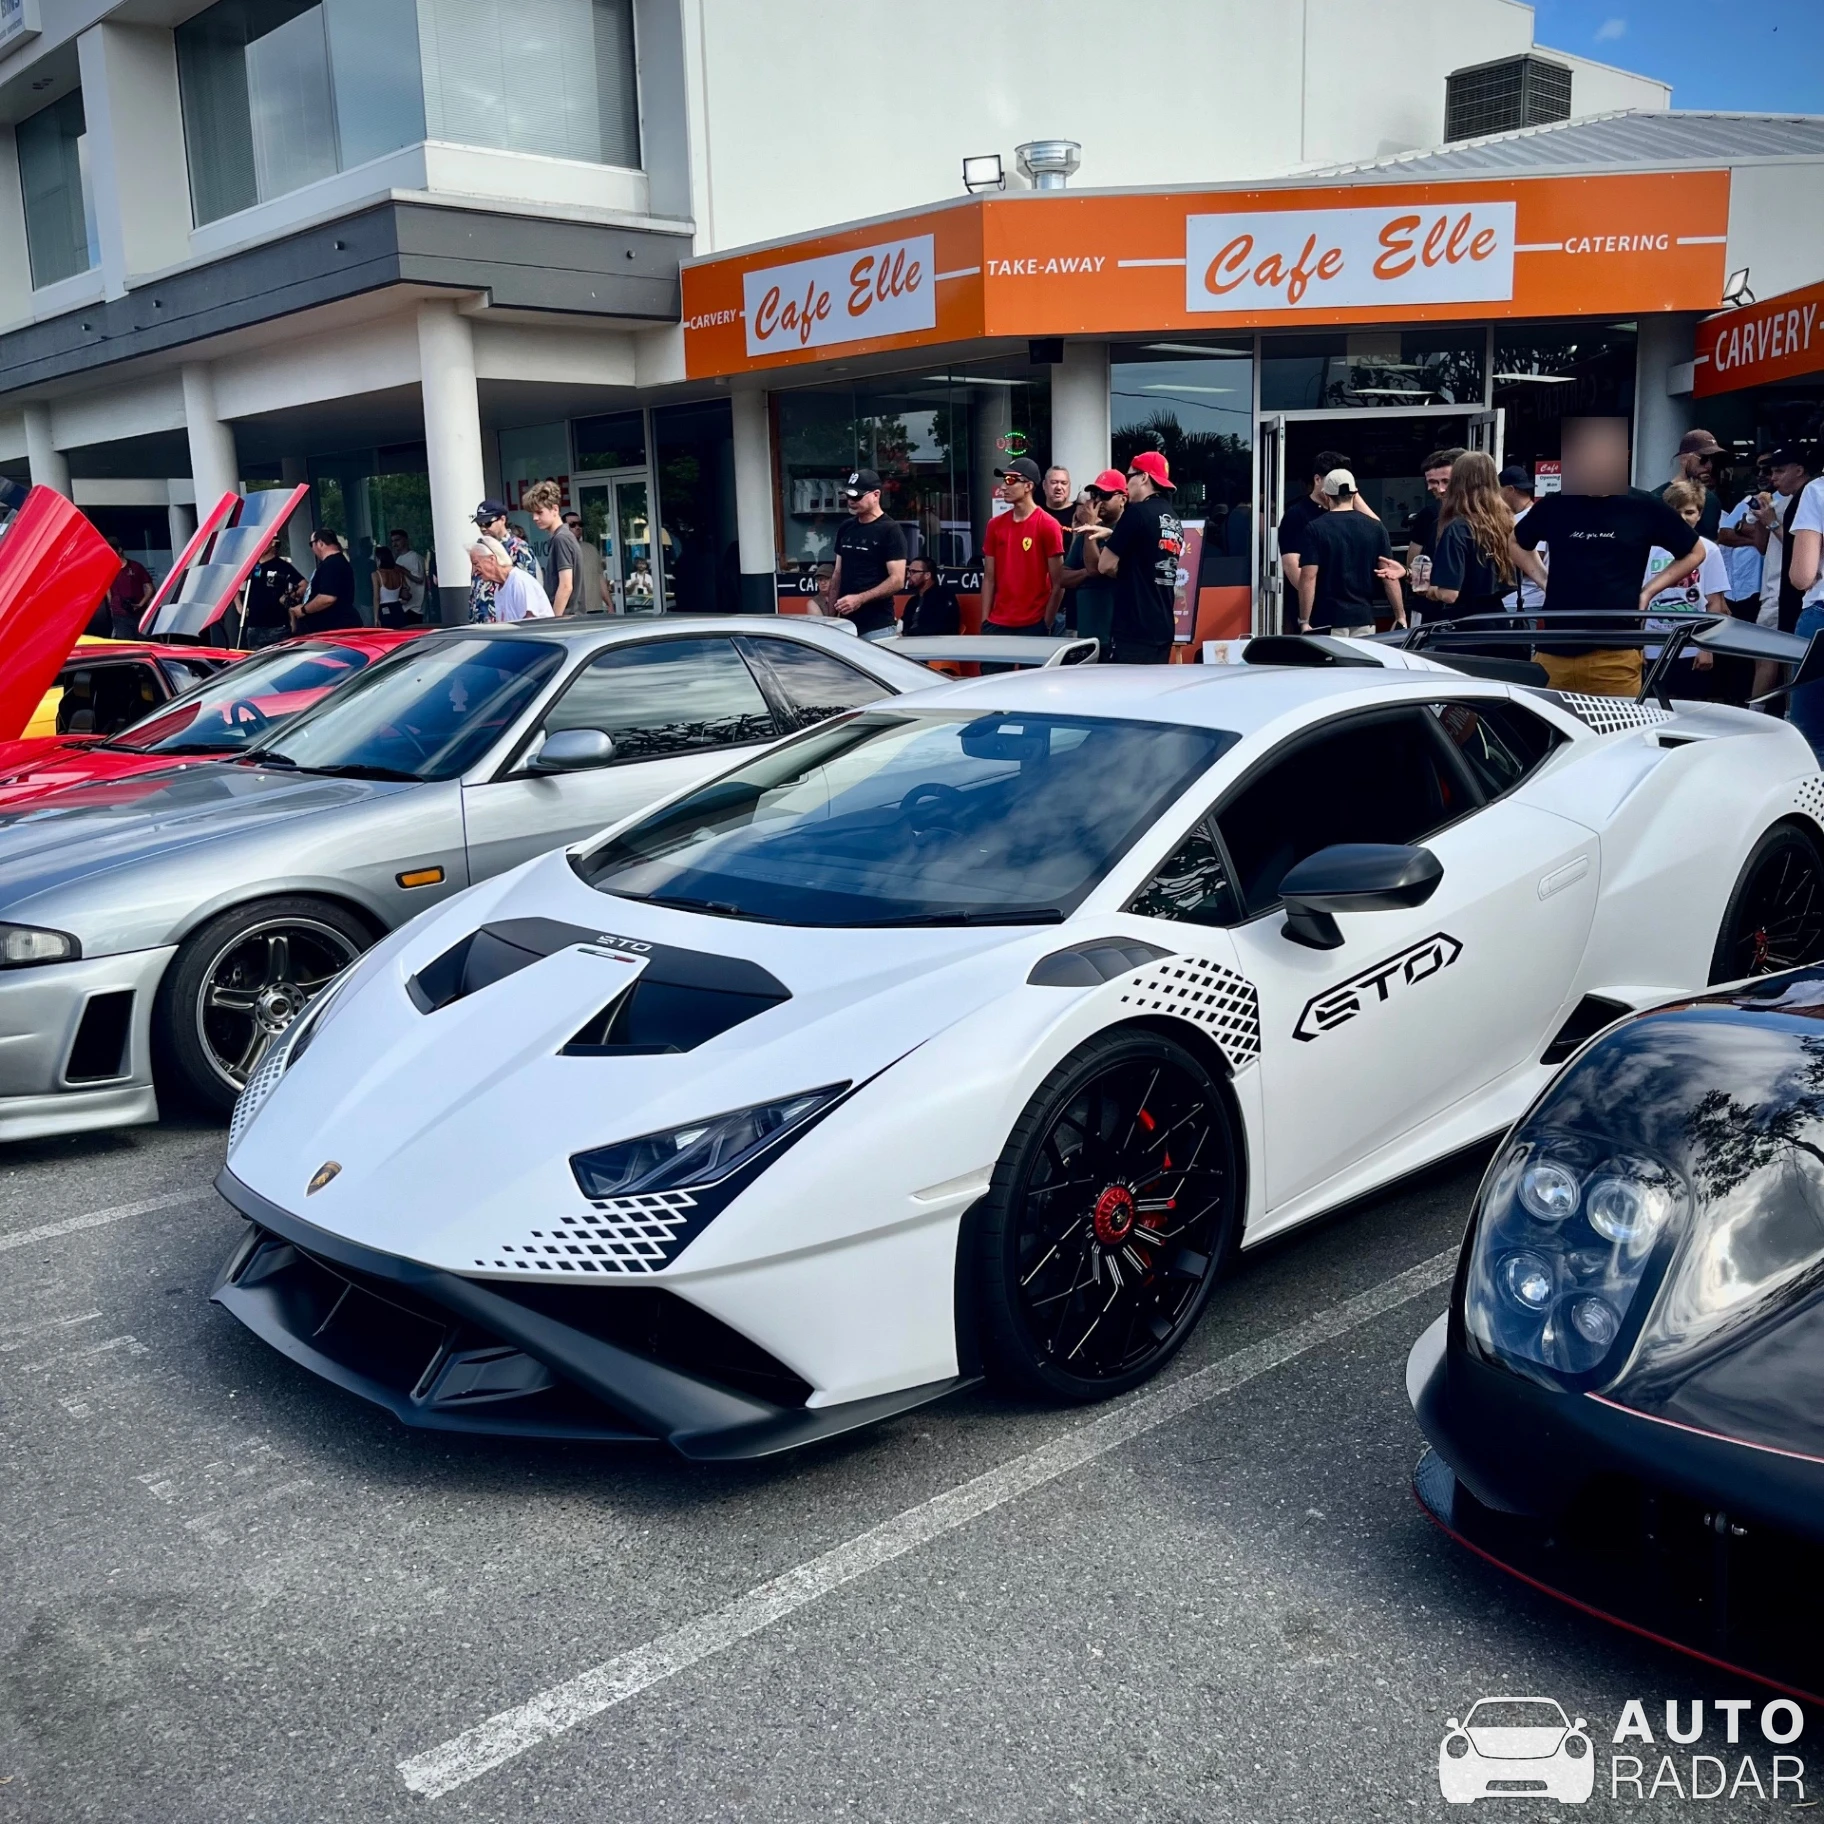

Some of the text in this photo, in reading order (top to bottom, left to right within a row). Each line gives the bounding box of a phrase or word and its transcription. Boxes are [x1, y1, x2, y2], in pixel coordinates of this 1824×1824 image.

[987, 256, 1106, 276] TAKE-AWAY
[1204, 212, 1497, 305] Cafe Elle
[1564, 234, 1669, 254] CATERING
[690, 308, 737, 330] CARVERY
[755, 248, 922, 345] Cafe Elle
[1715, 303, 1817, 372] CARVERY
[596, 935, 653, 952] STO
[1315, 943, 1443, 1031] STO
